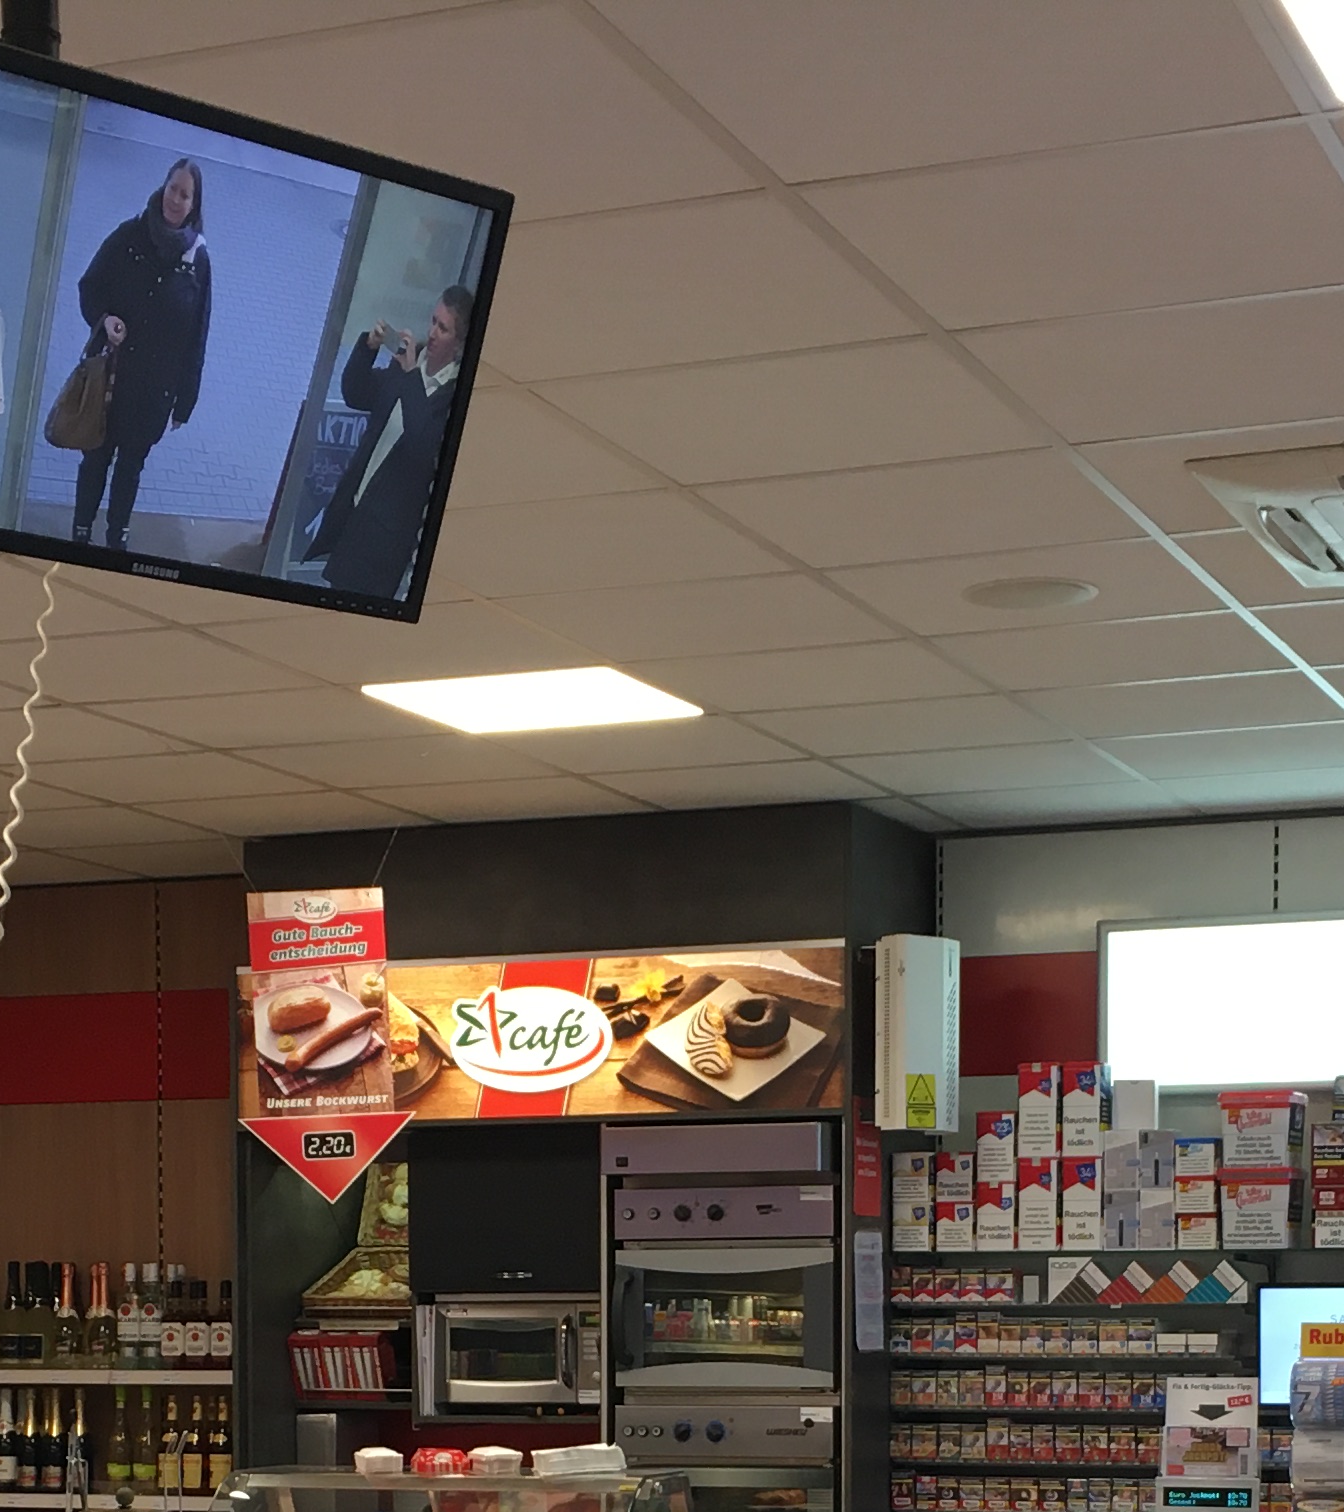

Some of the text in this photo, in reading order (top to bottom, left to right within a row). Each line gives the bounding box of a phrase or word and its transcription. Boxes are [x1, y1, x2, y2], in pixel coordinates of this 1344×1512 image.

[132, 562, 179, 579] SAMSUNG
[272, 923, 363, 943] Gute Bauch-
[269, 941, 367, 961] entscheidung
[508, 1009, 589, 1066] café
